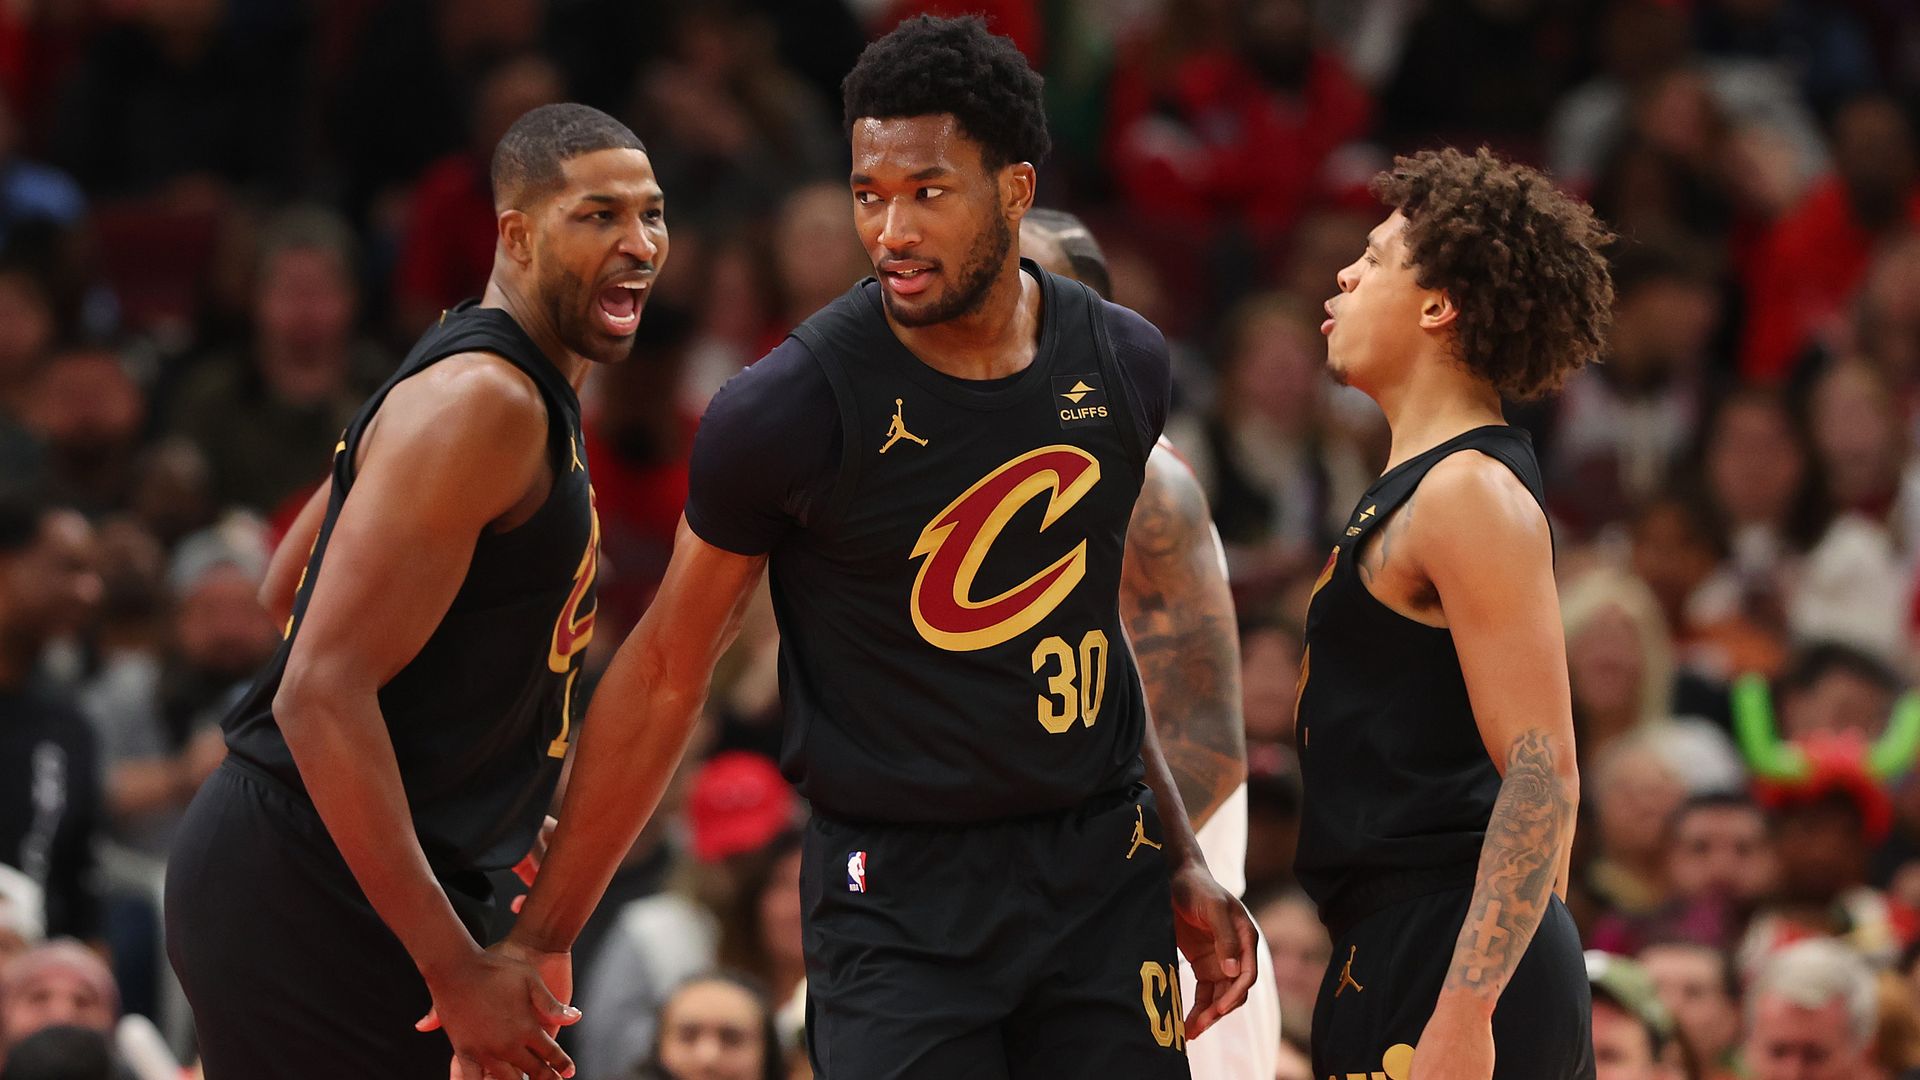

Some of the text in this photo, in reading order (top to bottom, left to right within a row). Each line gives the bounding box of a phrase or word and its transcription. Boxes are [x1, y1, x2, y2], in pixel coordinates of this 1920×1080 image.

[1060, 406, 1108, 421] CLIFFS
[909, 444, 1101, 651] C
[1031, 629, 1109, 734] 30
